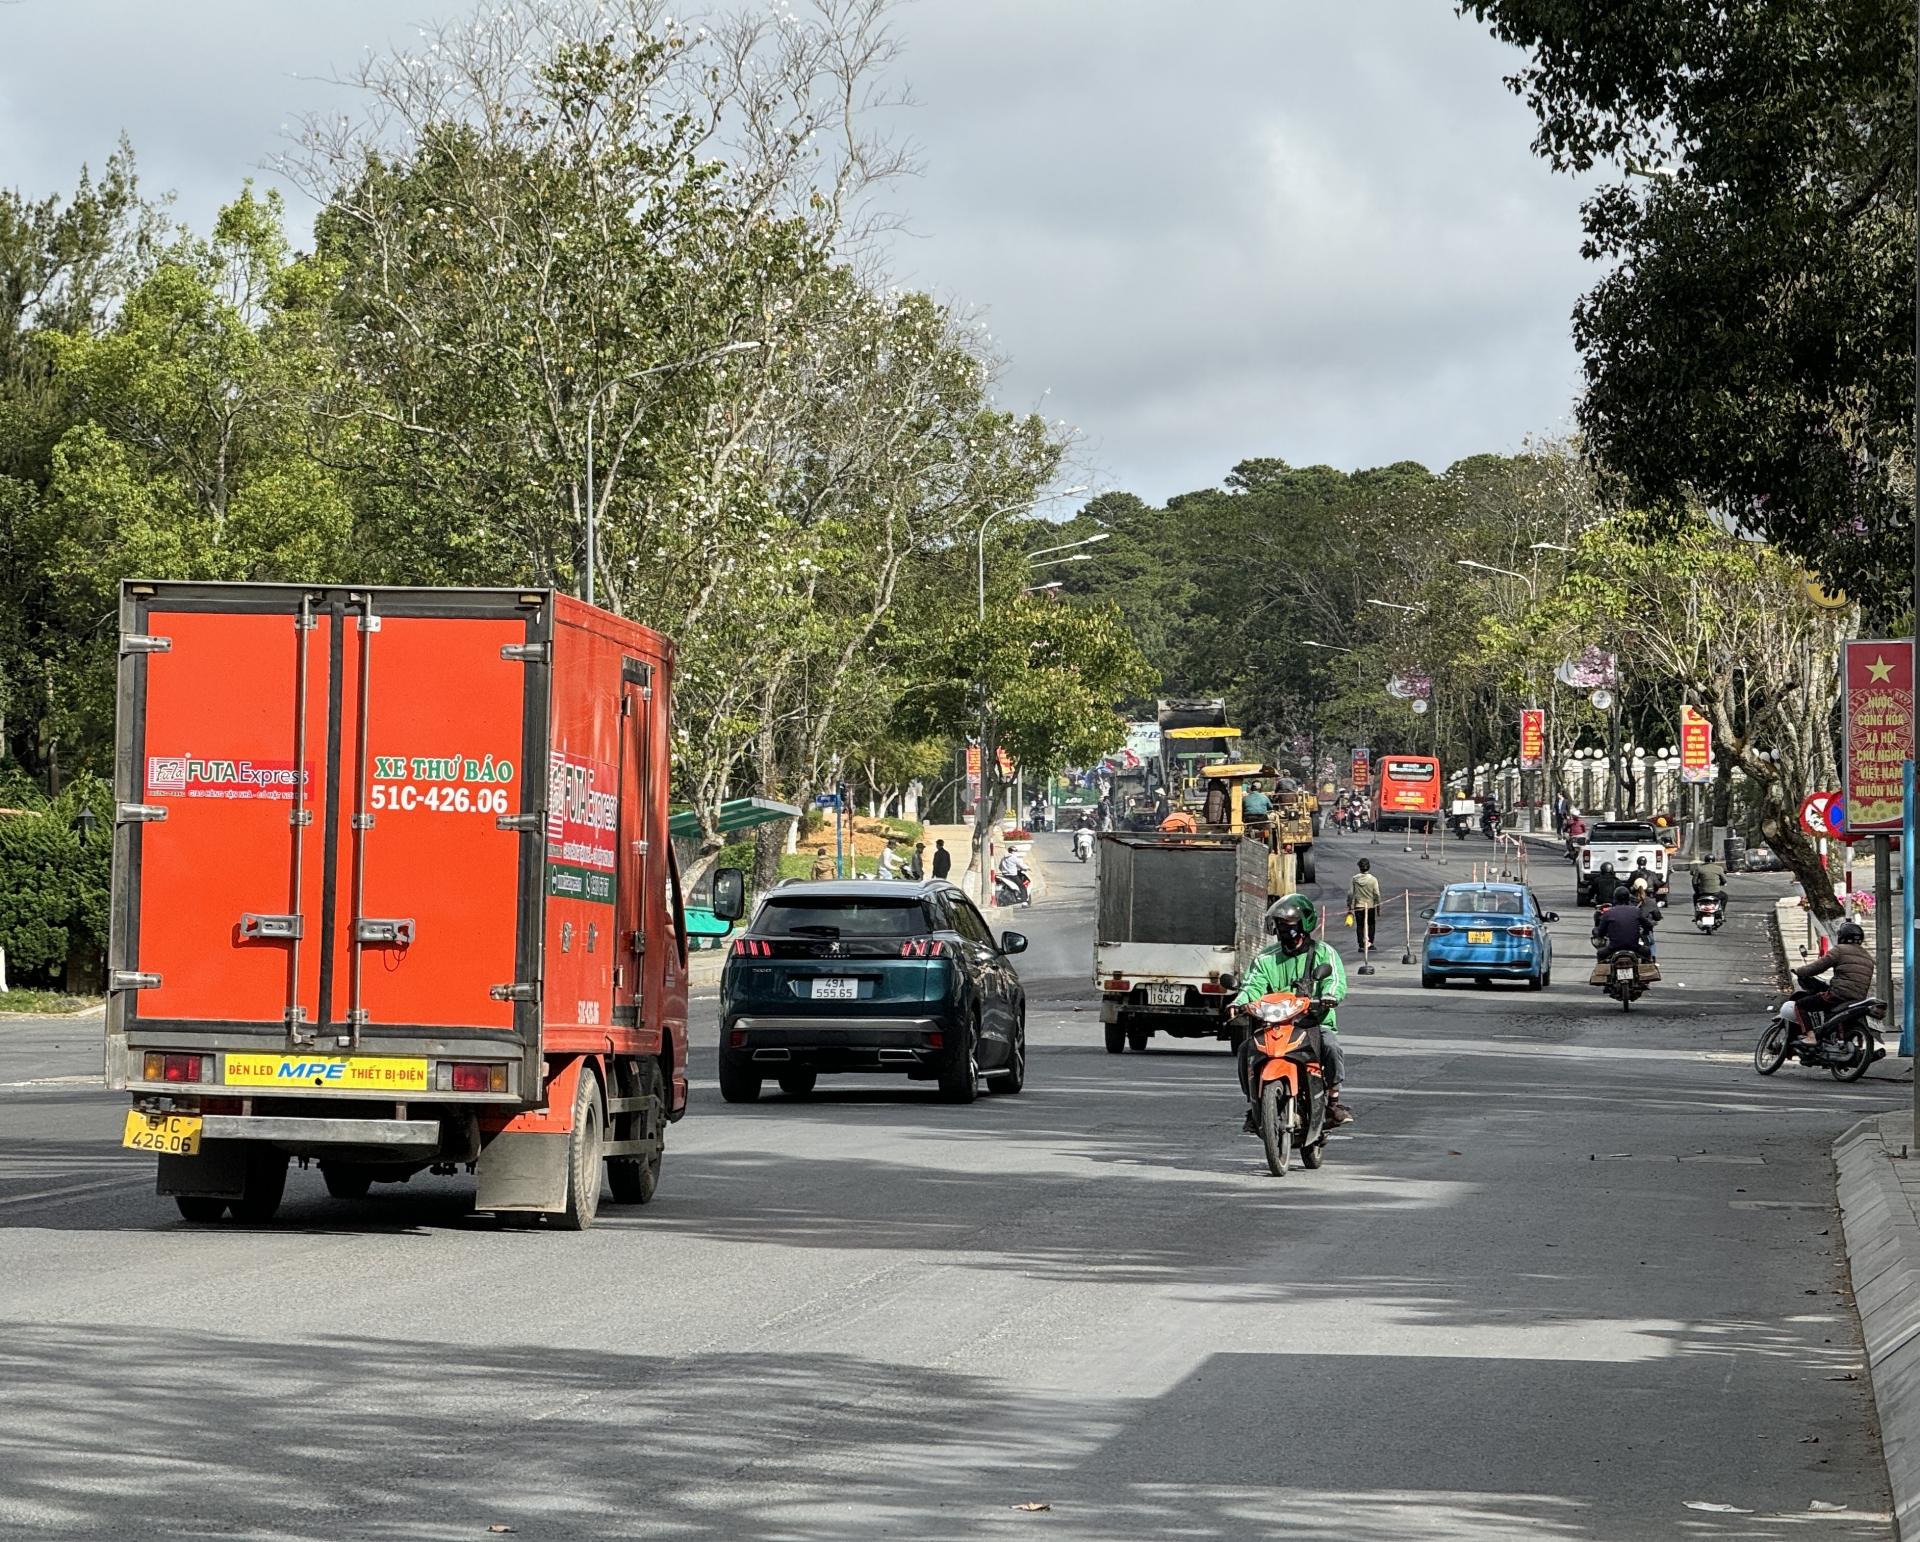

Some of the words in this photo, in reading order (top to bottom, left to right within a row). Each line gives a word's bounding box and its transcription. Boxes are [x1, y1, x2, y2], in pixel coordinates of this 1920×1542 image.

[1868, 694, 1893, 708] NƯỚC
[1858, 712, 1883, 728] CỘNG
[1866, 730, 1879, 743] XÃ
[1881, 730, 1897, 746] HỘI
[187, 760, 239, 783] FUTA
[374, 756, 406, 779] XE
[411, 754, 461, 781] THƯ
[463, 754, 514, 783] BÁO
[1860, 765, 1879, 781] VIỆT
[564, 763, 588, 826] FUTA
[1856, 782, 1884, 797] MUÔN
[371, 785, 508, 814] 51C-426.06
[825, 979, 845, 988] 49A
[1158, 984, 1175, 994] 49C
[816, 989, 853, 998] 555.65
[1153, 994, 1180, 1004] 194.42
[229, 1062, 250, 1075] ĐÈN
[253, 1065, 273, 1076] LED
[277, 1062, 346, 1079] MPE
[351, 1065, 381, 1079] THIẾT
[385, 1070, 396, 1082] BỊ
[397, 1067, 424, 1083] ĐIỆN
[149, 1115, 181, 1133] 51C
[132, 1132, 192, 1152] 426.06
